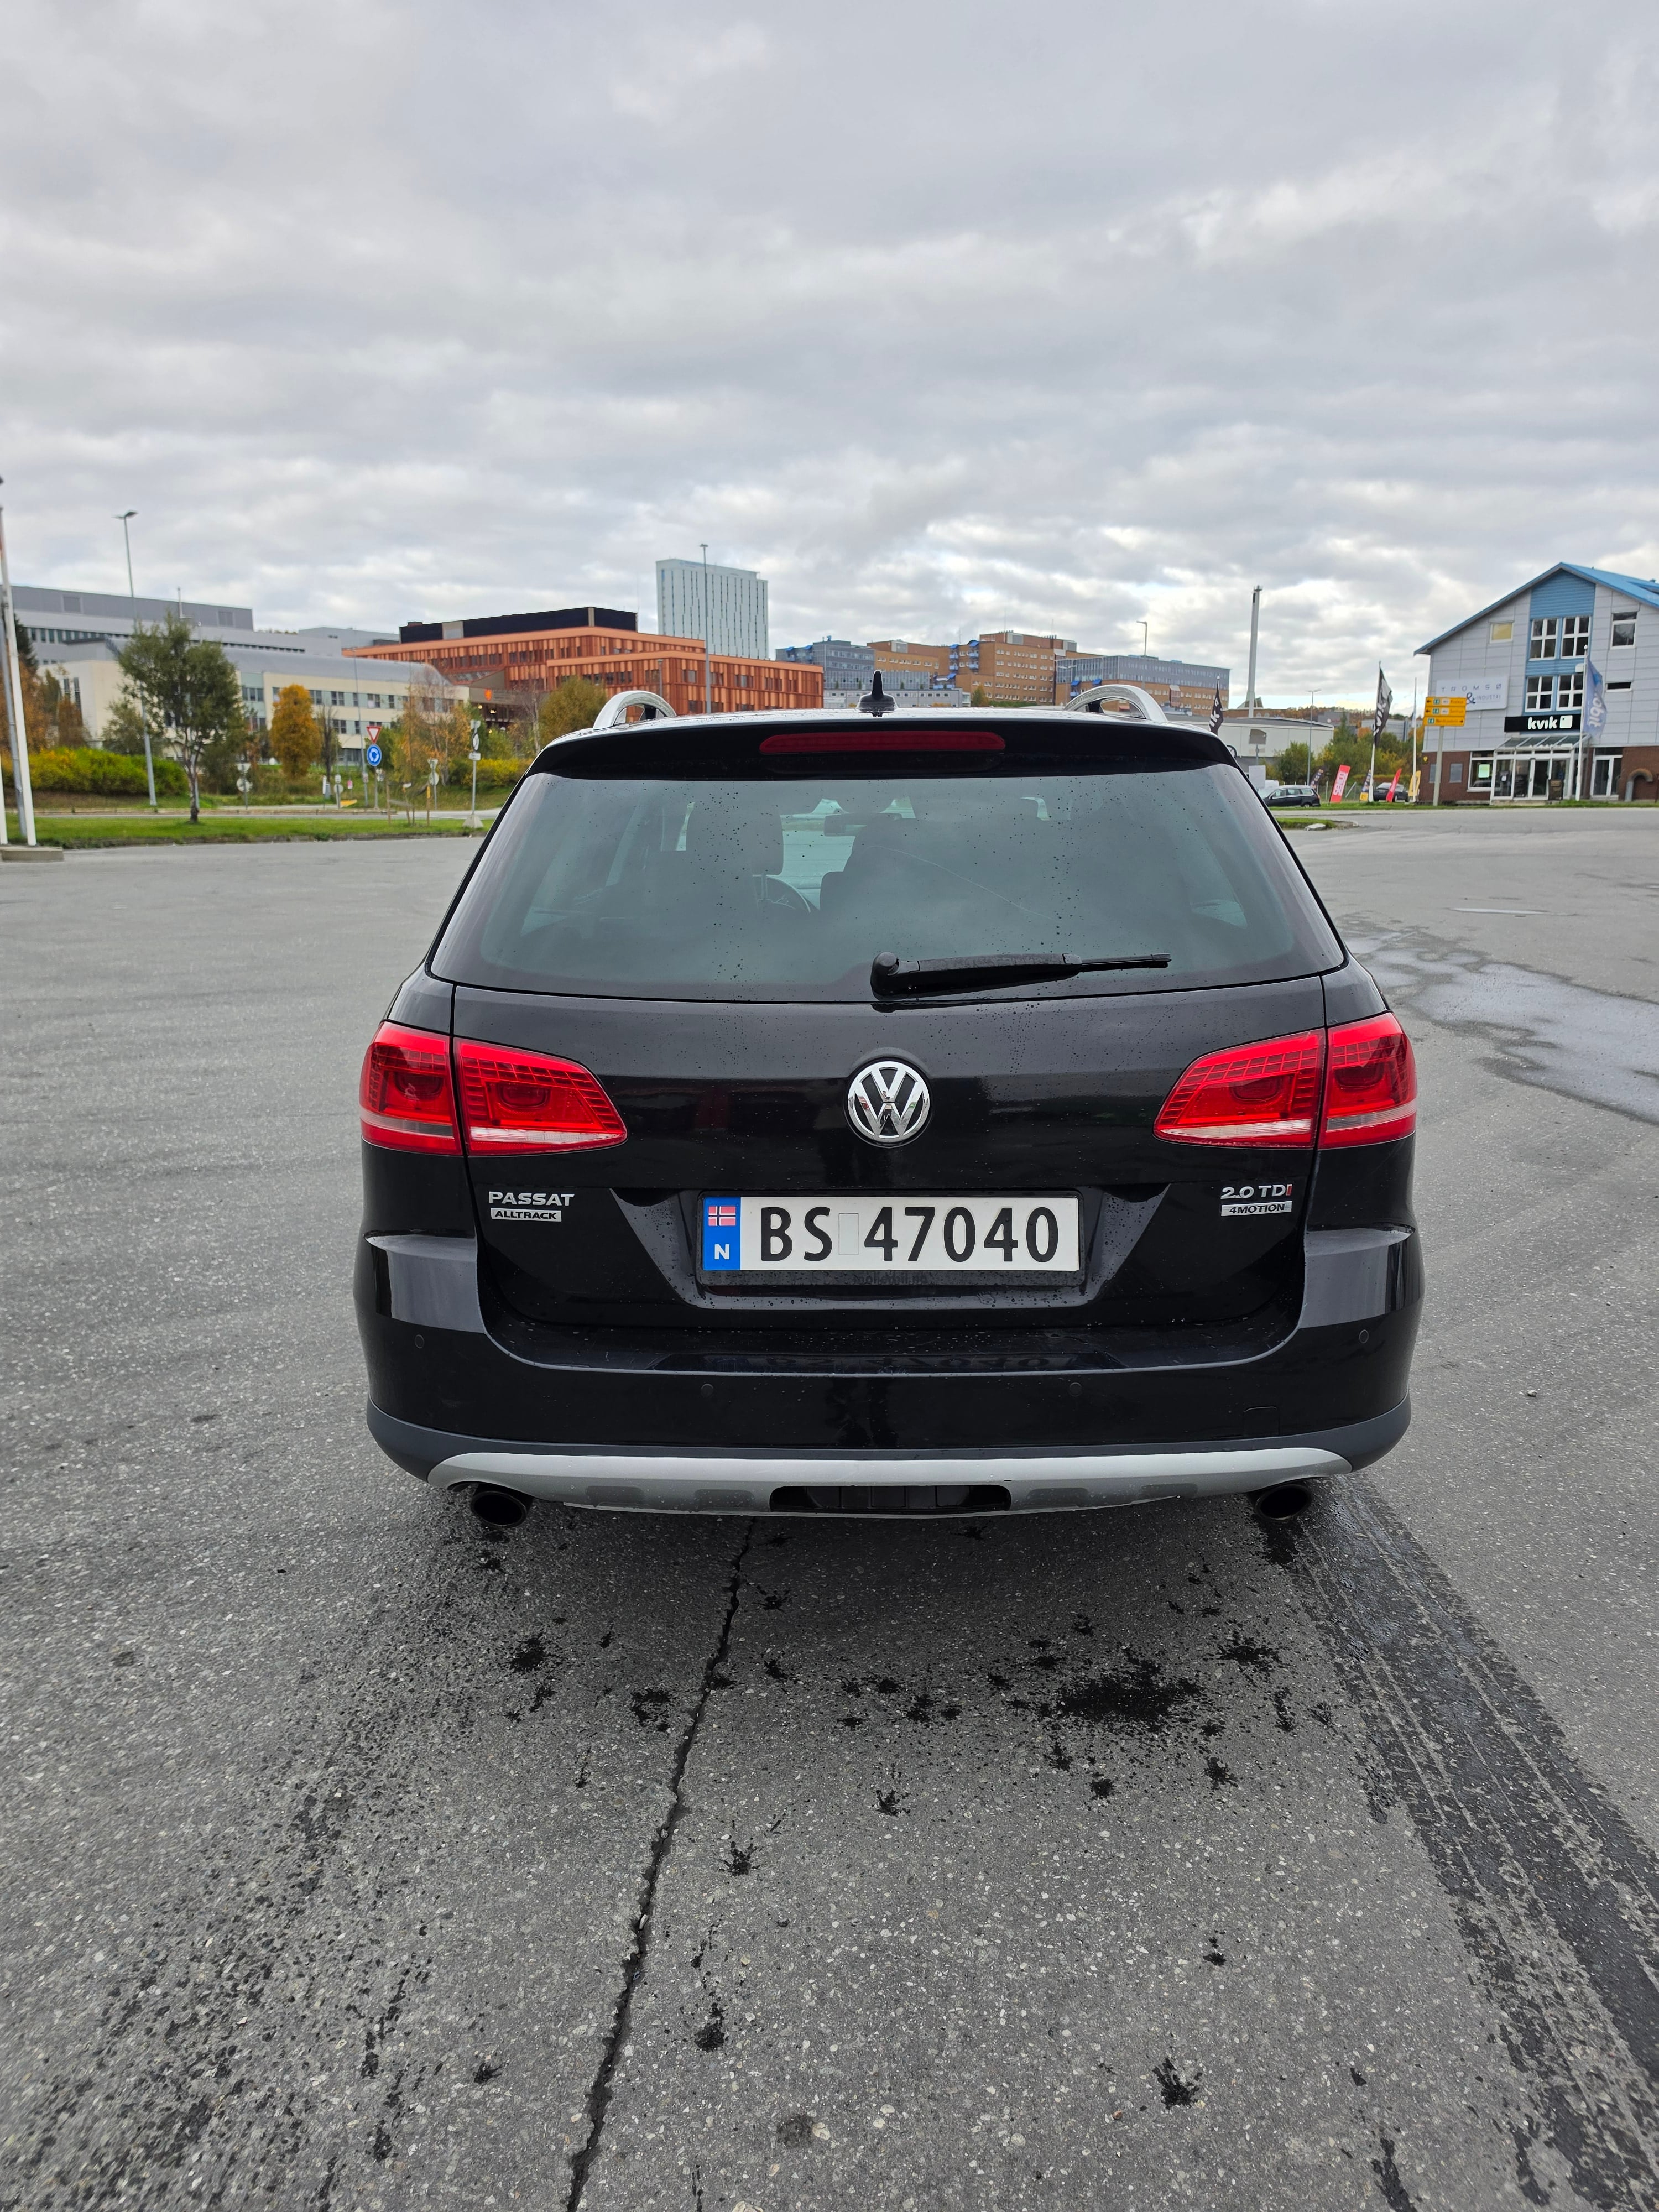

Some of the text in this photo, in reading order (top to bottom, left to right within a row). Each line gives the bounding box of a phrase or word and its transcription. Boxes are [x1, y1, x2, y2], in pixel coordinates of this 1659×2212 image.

[1527, 716, 1558, 730] kvik
[488, 1191, 575, 1206] PASSAT
[1220, 1183, 1293, 1199] 2.0 TDI
[495, 1211, 557, 1220] ALLTRACK
[1229, 1203, 1285, 1214] 4MOTION
[761, 1206, 1060, 1263] BS 47040
[714, 1244, 730, 1260] N
